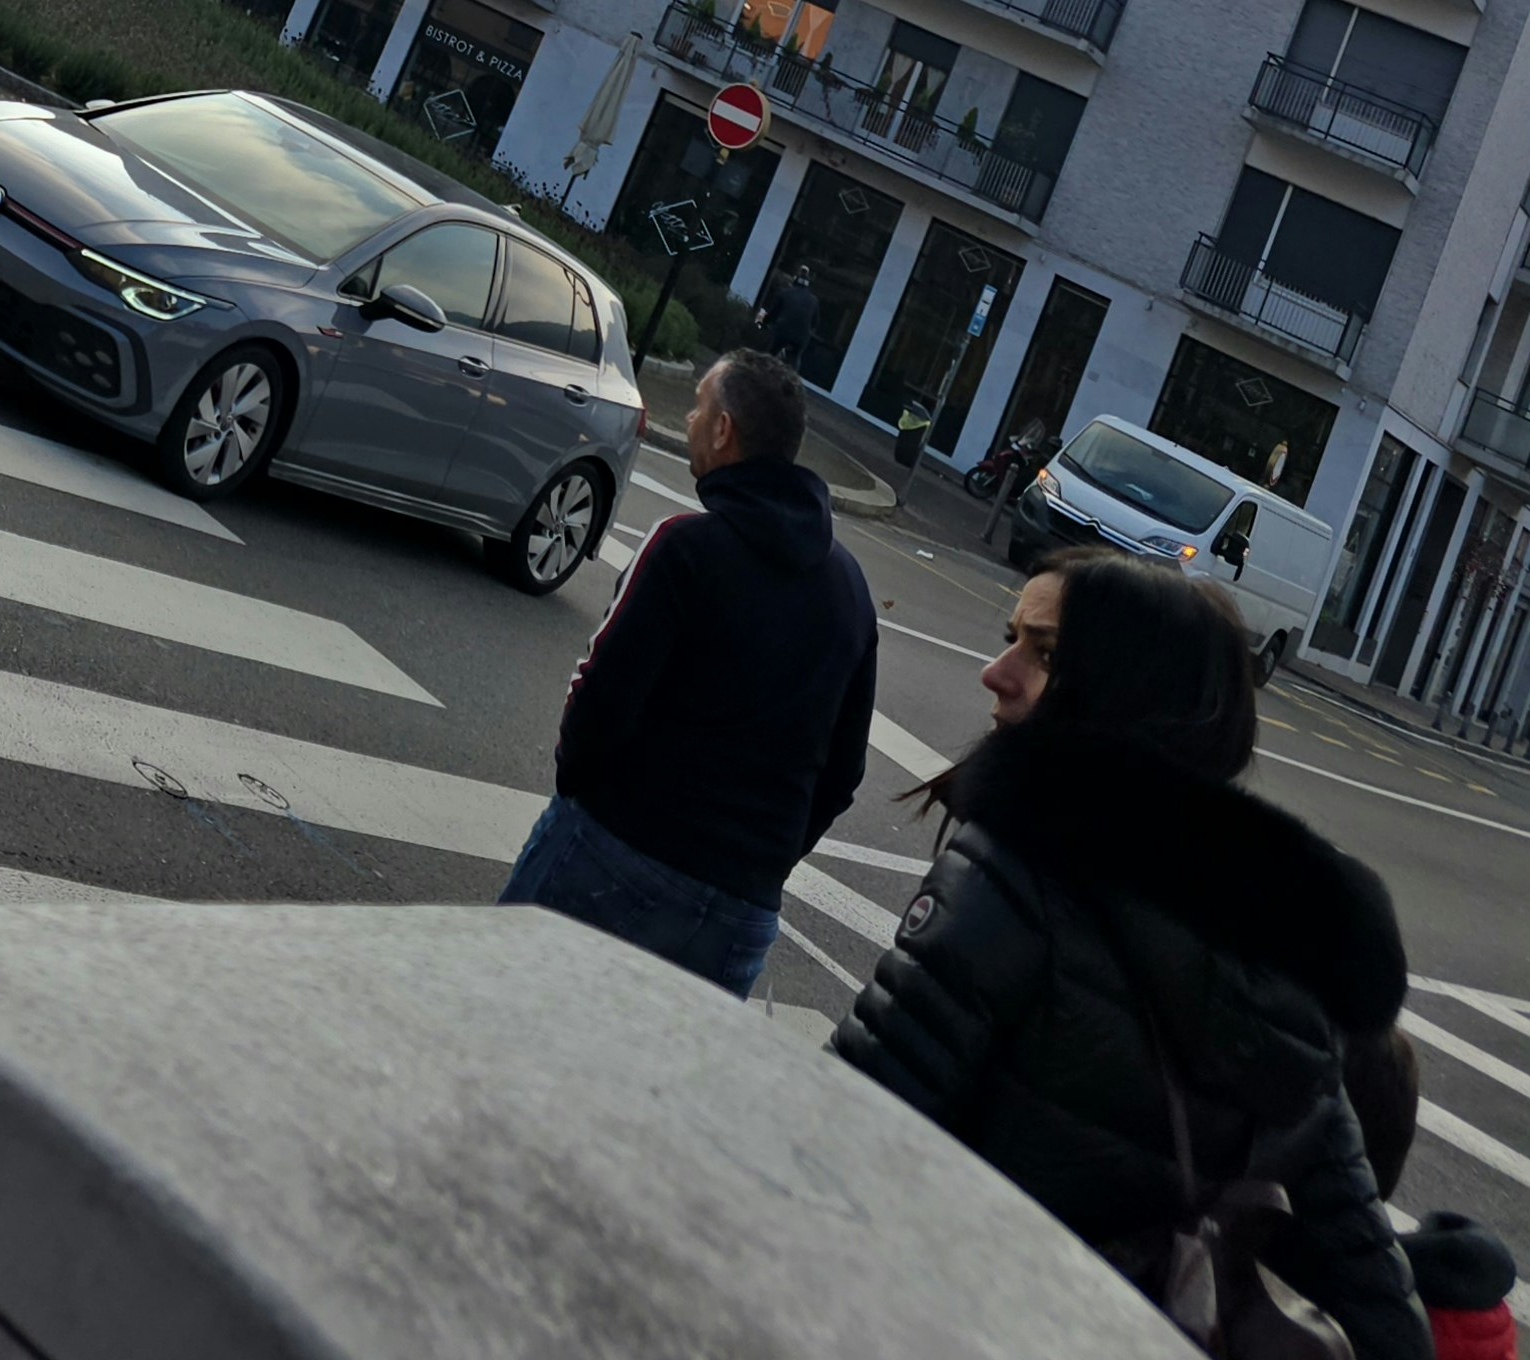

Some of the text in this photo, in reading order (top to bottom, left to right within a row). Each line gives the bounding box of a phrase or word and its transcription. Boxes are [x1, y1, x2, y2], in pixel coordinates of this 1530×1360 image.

[425, 24, 523, 81] BISTROT & PIZZA
